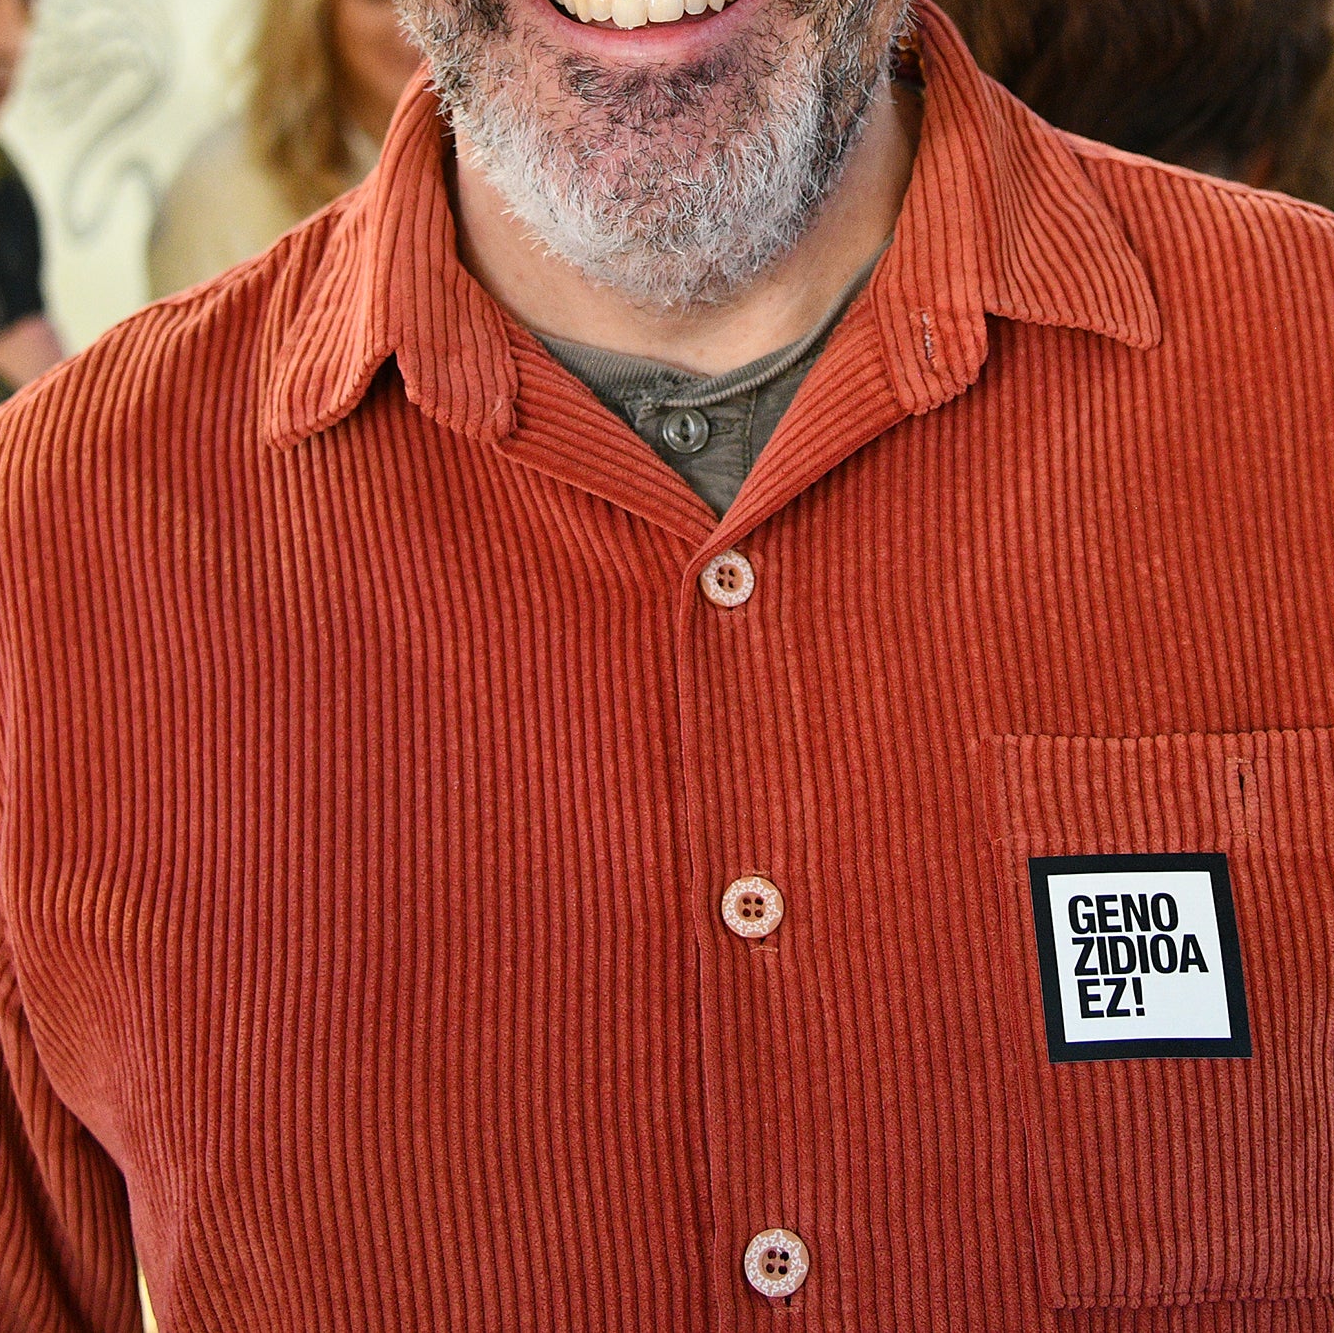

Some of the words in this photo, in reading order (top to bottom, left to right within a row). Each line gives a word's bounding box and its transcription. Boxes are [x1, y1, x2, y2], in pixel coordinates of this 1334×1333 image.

[1068, 892, 1179, 934] GENO
[1071, 933, 1209, 976] ZIDIOA
[1077, 976, 1146, 1019] EZ!
